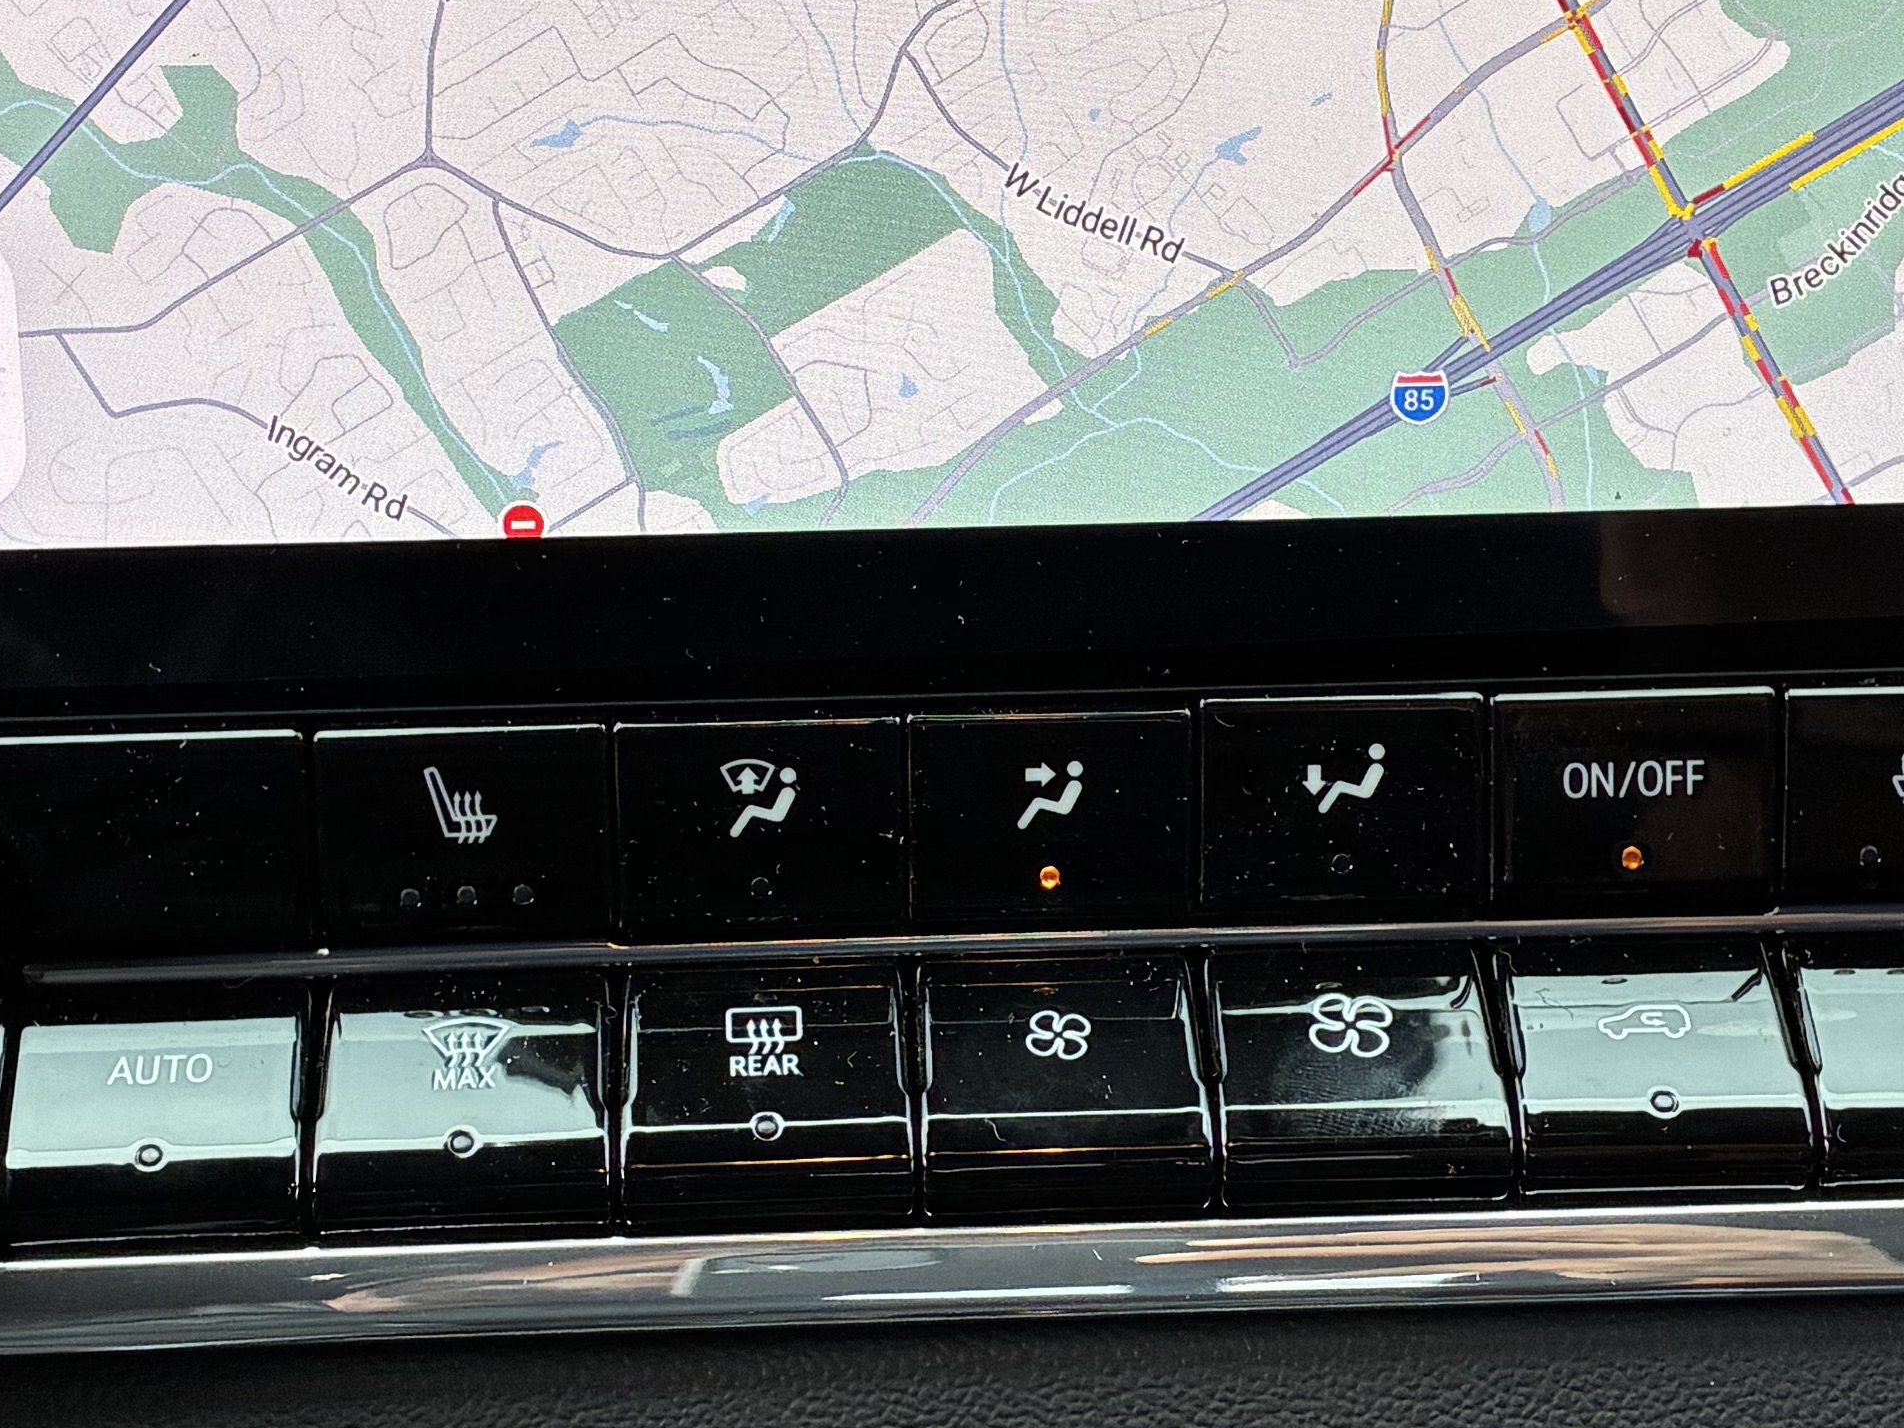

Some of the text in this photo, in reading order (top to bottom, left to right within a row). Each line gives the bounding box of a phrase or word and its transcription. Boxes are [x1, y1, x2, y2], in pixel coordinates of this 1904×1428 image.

[1004, 163, 1185, 263] W Liddell Rd
[1404, 389, 1434, 411] 85
[266, 413, 411, 522] Ingram Rd
[1563, 759, 1705, 800] ON/OFF
[107, 1053, 213, 1086] AUTO
[432, 1064, 496, 1092] MAX
[729, 1053, 800, 1078] REAR
